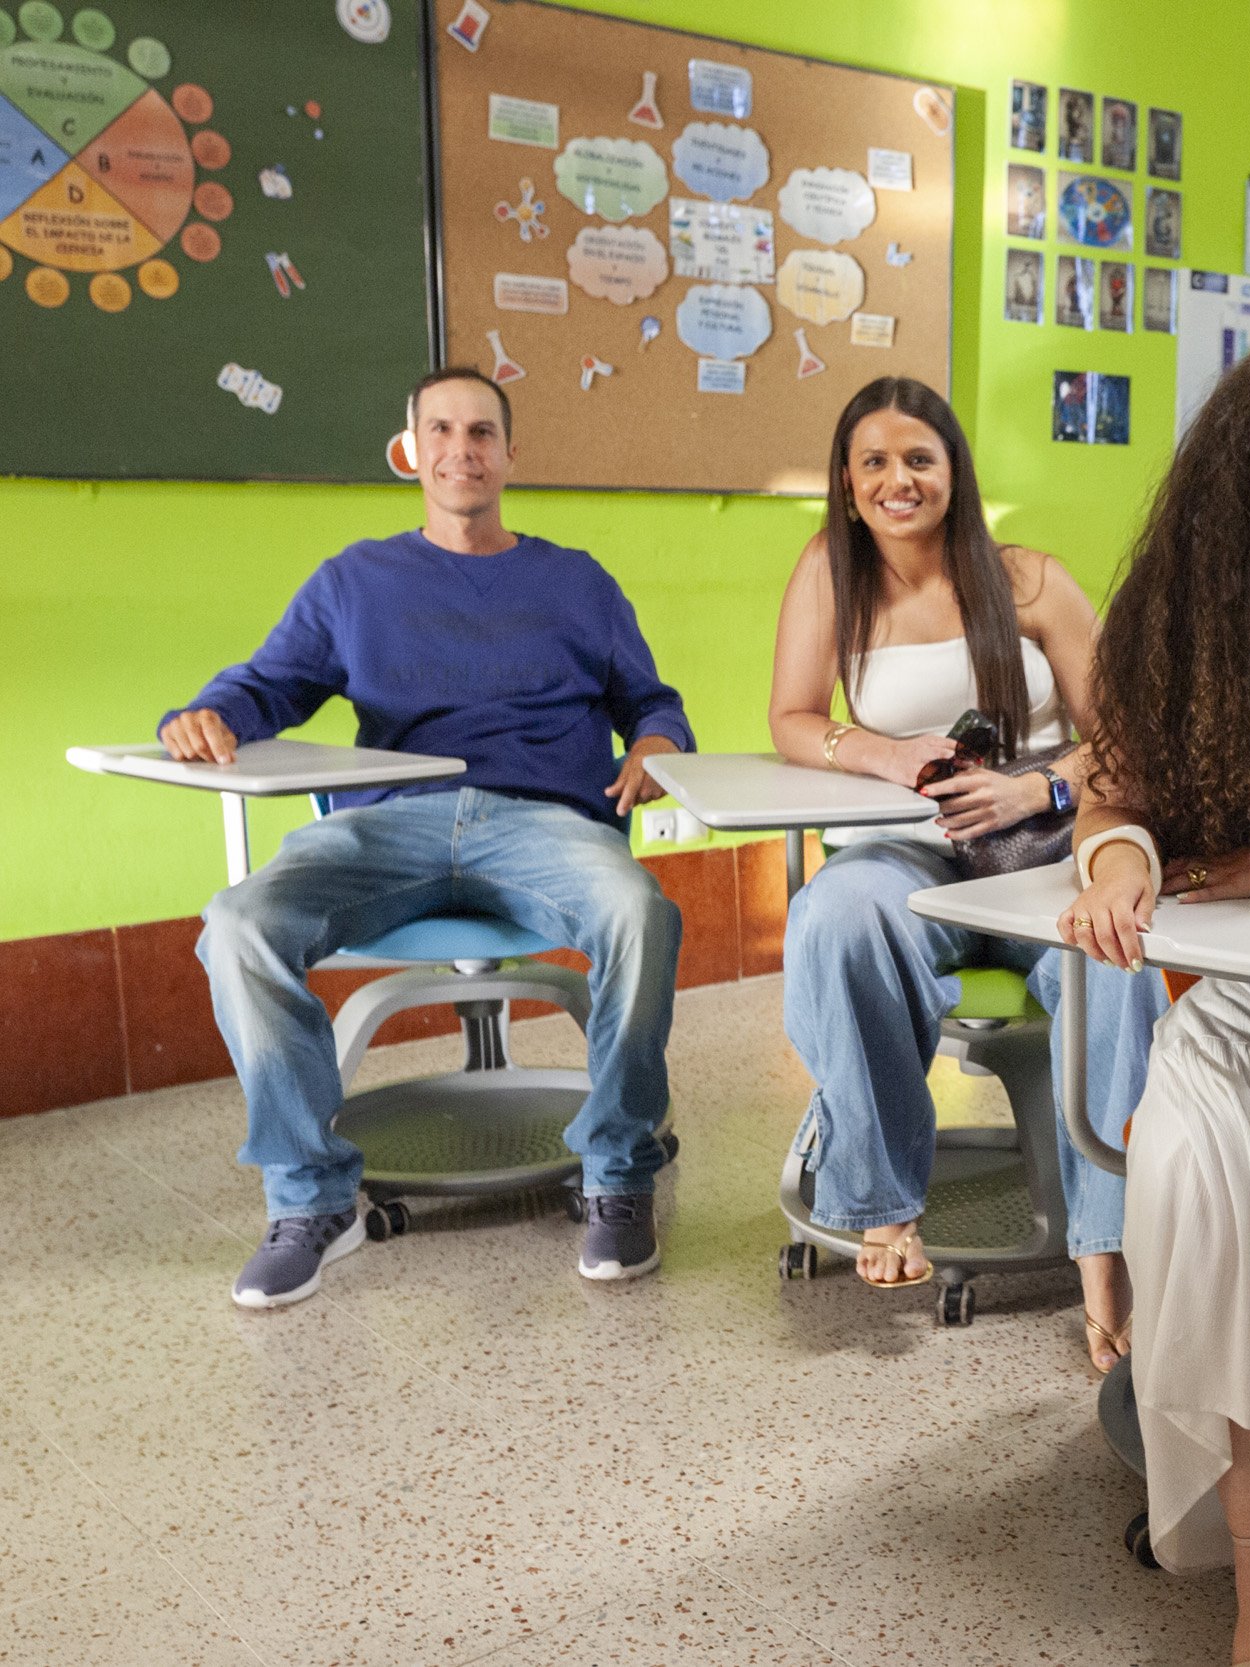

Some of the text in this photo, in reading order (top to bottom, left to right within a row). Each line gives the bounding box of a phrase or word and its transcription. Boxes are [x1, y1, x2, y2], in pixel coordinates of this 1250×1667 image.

[61, 117, 76, 136] C
[30, 147, 46, 166] A
[97, 152, 112, 173] B
[68, 184, 85, 204] D
[23, 213, 130, 231] REFLEXIÓN SOBRE
[25, 227, 39, 239] EL
[43, 228, 95, 241] IMPACTO
[117, 232, 131, 244] LA
